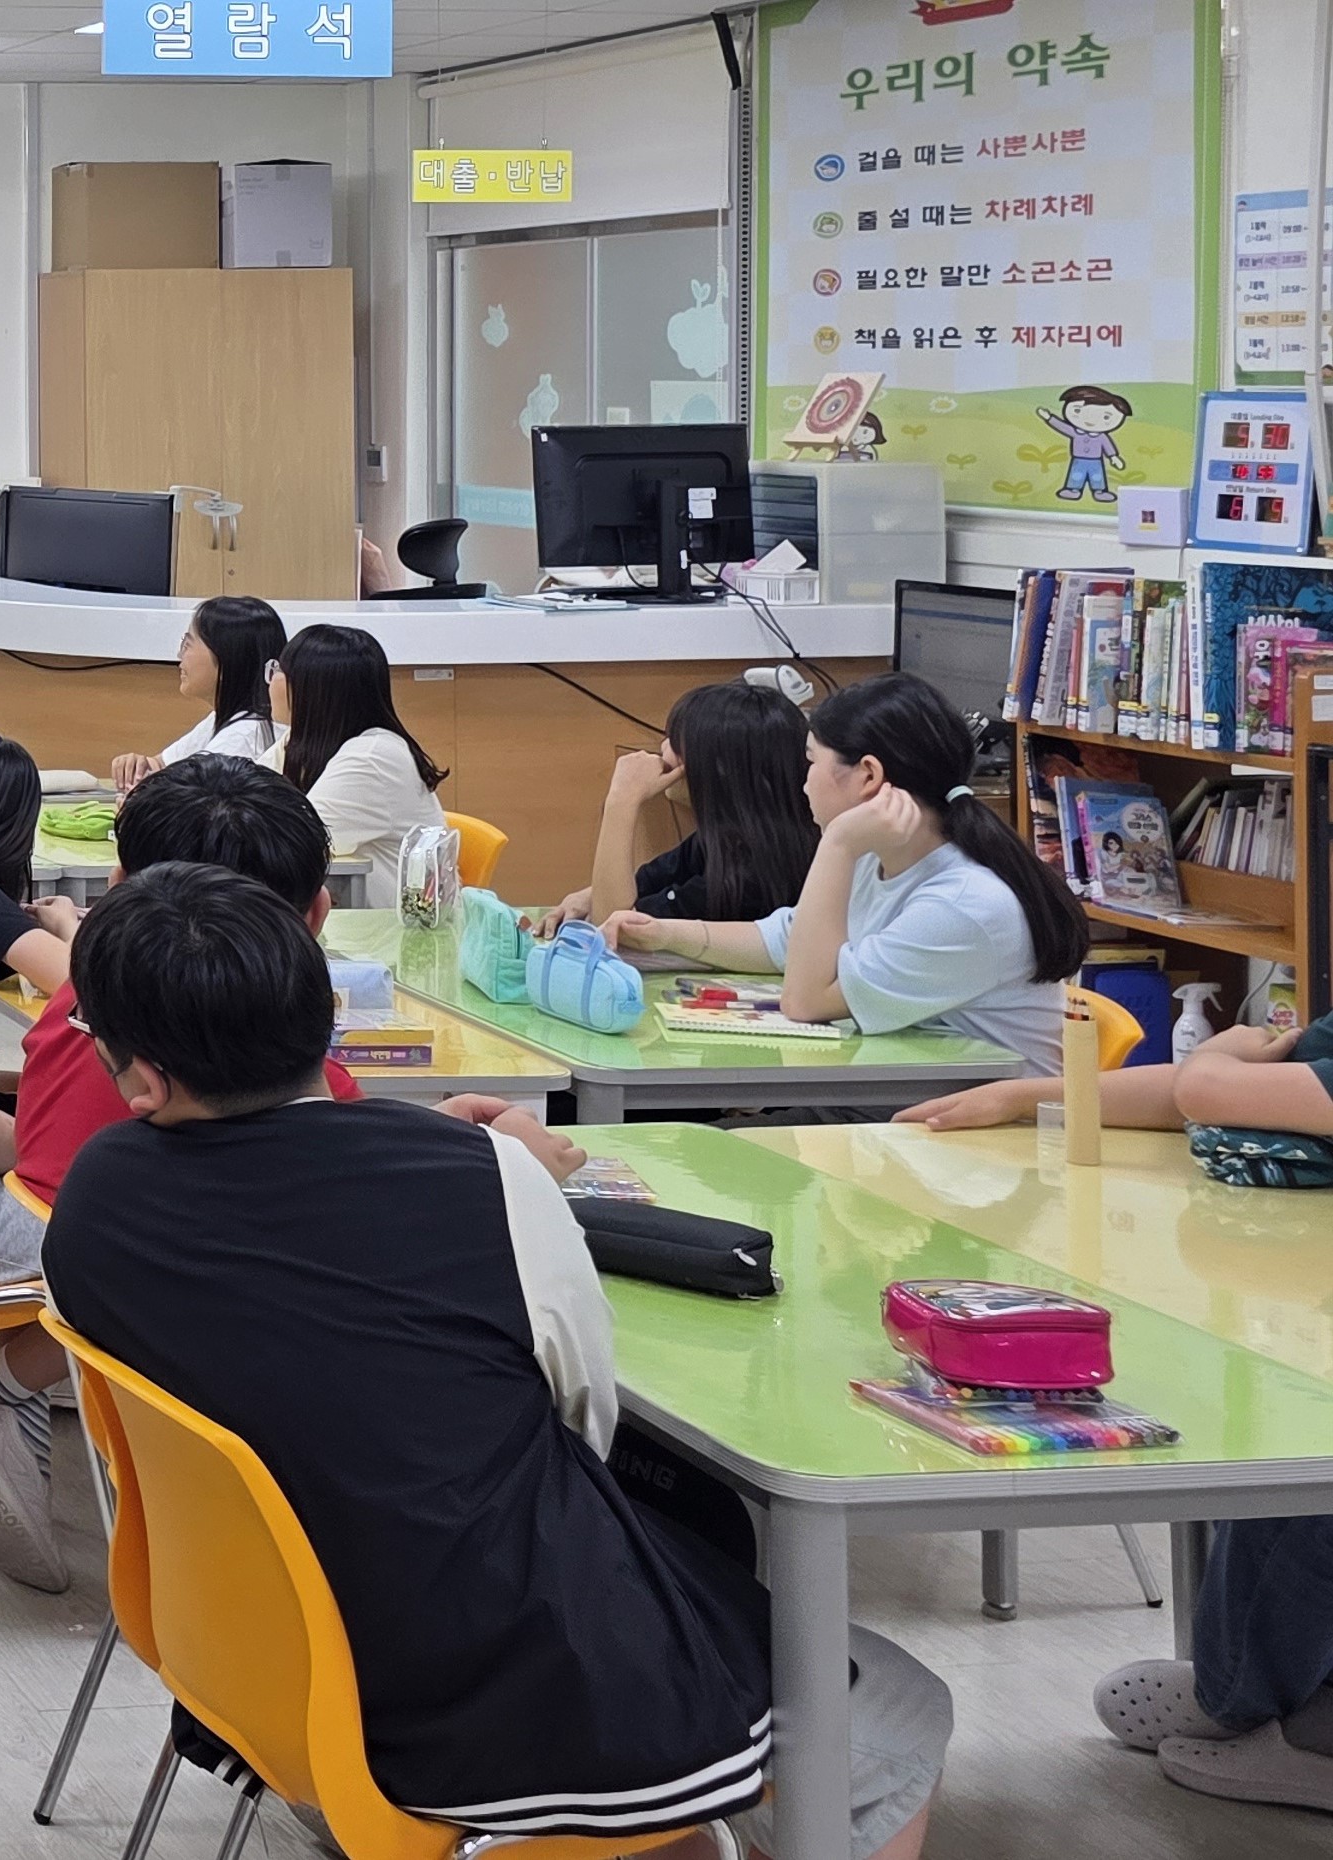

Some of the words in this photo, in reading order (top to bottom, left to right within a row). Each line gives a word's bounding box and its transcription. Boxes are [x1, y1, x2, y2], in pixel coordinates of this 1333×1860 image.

[840, 51, 976, 110] 우리의
[1006, 32, 1110, 86] 약속
[858, 148, 902, 172] 걸을
[914, 143, 964, 166] 때는
[977, 128, 1086, 159] 사뿐사뿐
[857, 210, 877, 231] 줄
[889, 207, 910, 228] 설
[923, 204, 972, 226] 때는
[985, 193, 1093, 221] 차례차례
[856, 266, 928, 290] 필요한
[940, 264, 990, 286] 말만
[1001, 258, 1113, 284] 소곤소곤
[854, 327, 901, 349] 책을
[913, 326, 962, 349] 읽은
[974, 326, 997, 348] 후
[1012, 324, 1122, 348] 제자리에
[1264, 425, 1288, 447] 30
